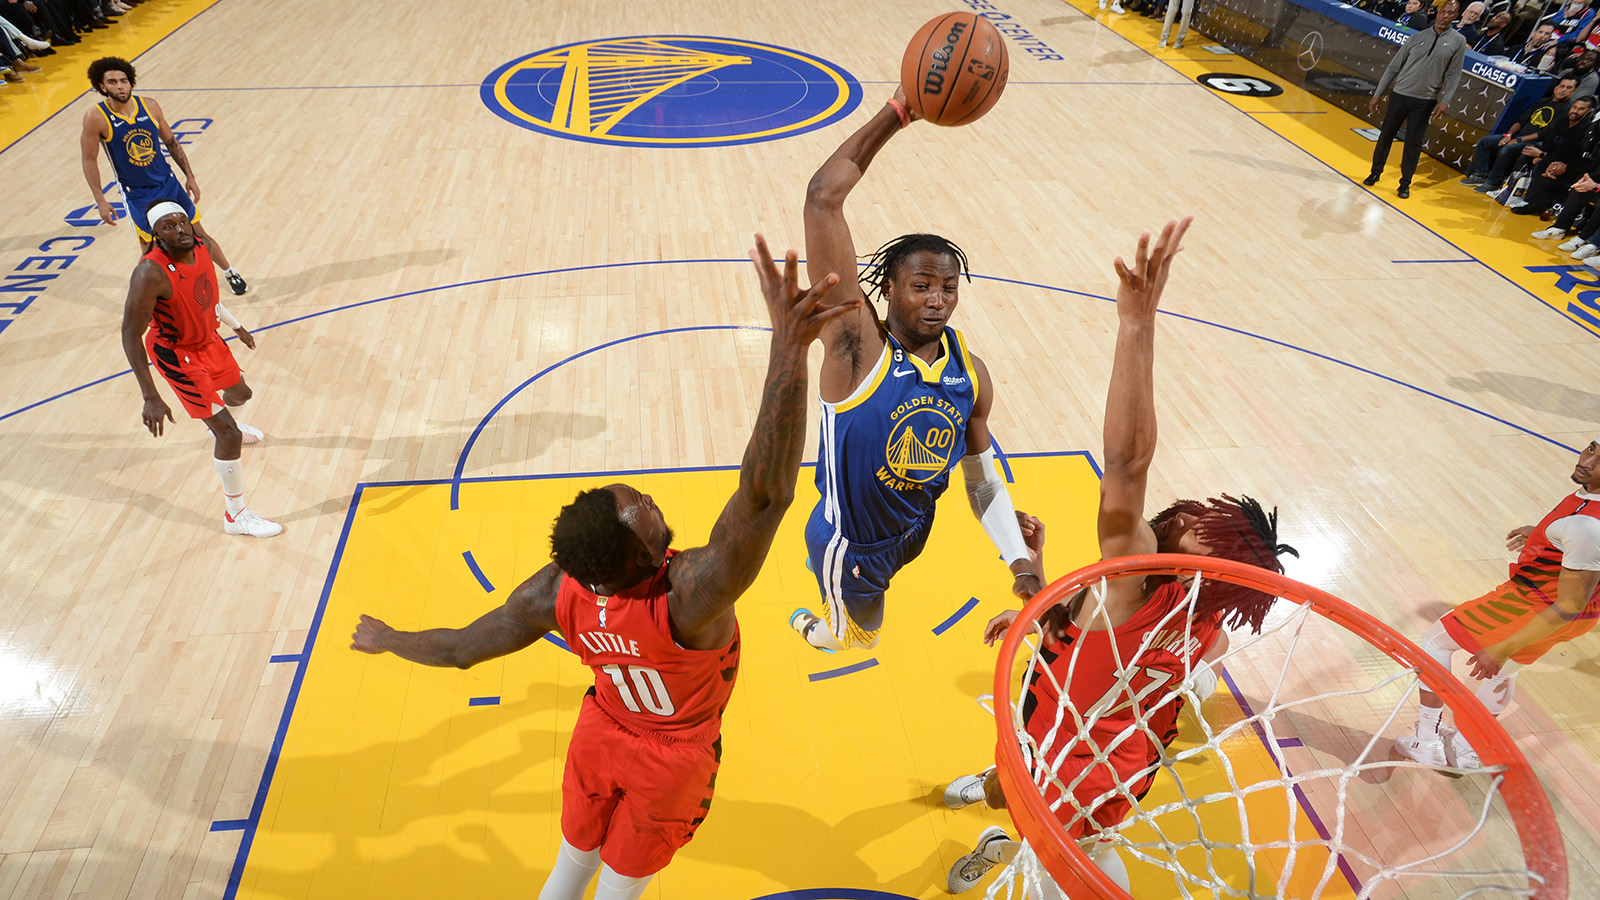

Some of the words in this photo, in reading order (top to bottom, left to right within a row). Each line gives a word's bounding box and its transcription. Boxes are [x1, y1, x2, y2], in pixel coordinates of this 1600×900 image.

[994, 22, 1064, 61] CENTER
[1379, 26, 1410, 45] CHASE
[923, 22, 968, 96] Wilson
[1471, 62, 1508, 83] CHASE
[139, 138, 150, 148] 40
[890, 396, 934, 421] GOLDEN
[936, 398, 964, 426] STATE
[925, 427, 952, 448] 00
[578, 631, 641, 657] LITTLE
[601, 664, 675, 717] 10
[1082, 665, 1175, 718] 17
